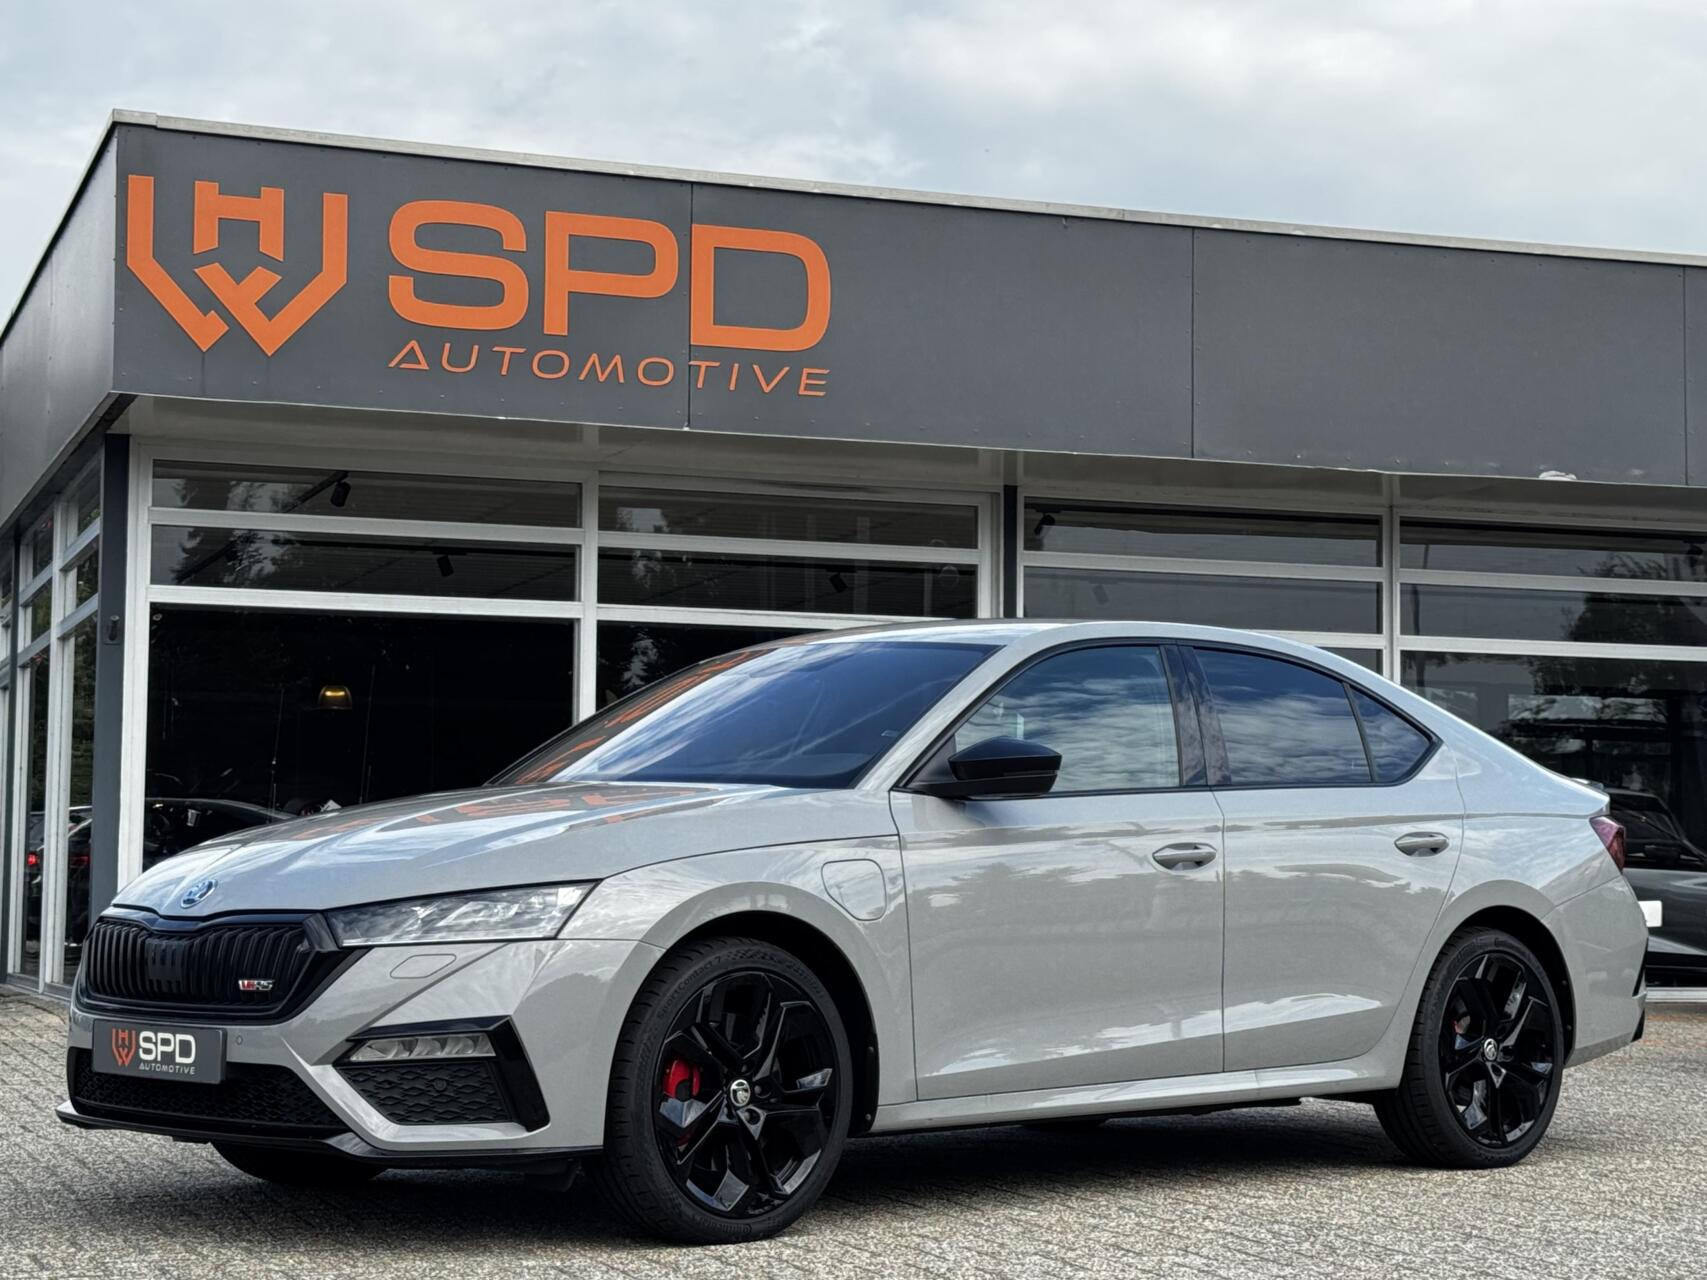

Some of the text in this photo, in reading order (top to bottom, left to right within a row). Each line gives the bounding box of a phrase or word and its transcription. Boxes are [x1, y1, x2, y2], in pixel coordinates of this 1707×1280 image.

[388, 200, 831, 352] SPD
[389, 340, 830, 397] AUTOMOTIVE
[139, 1031, 196, 1064] SPD
[139, 1062, 196, 1075] AUTOMOTIVE
